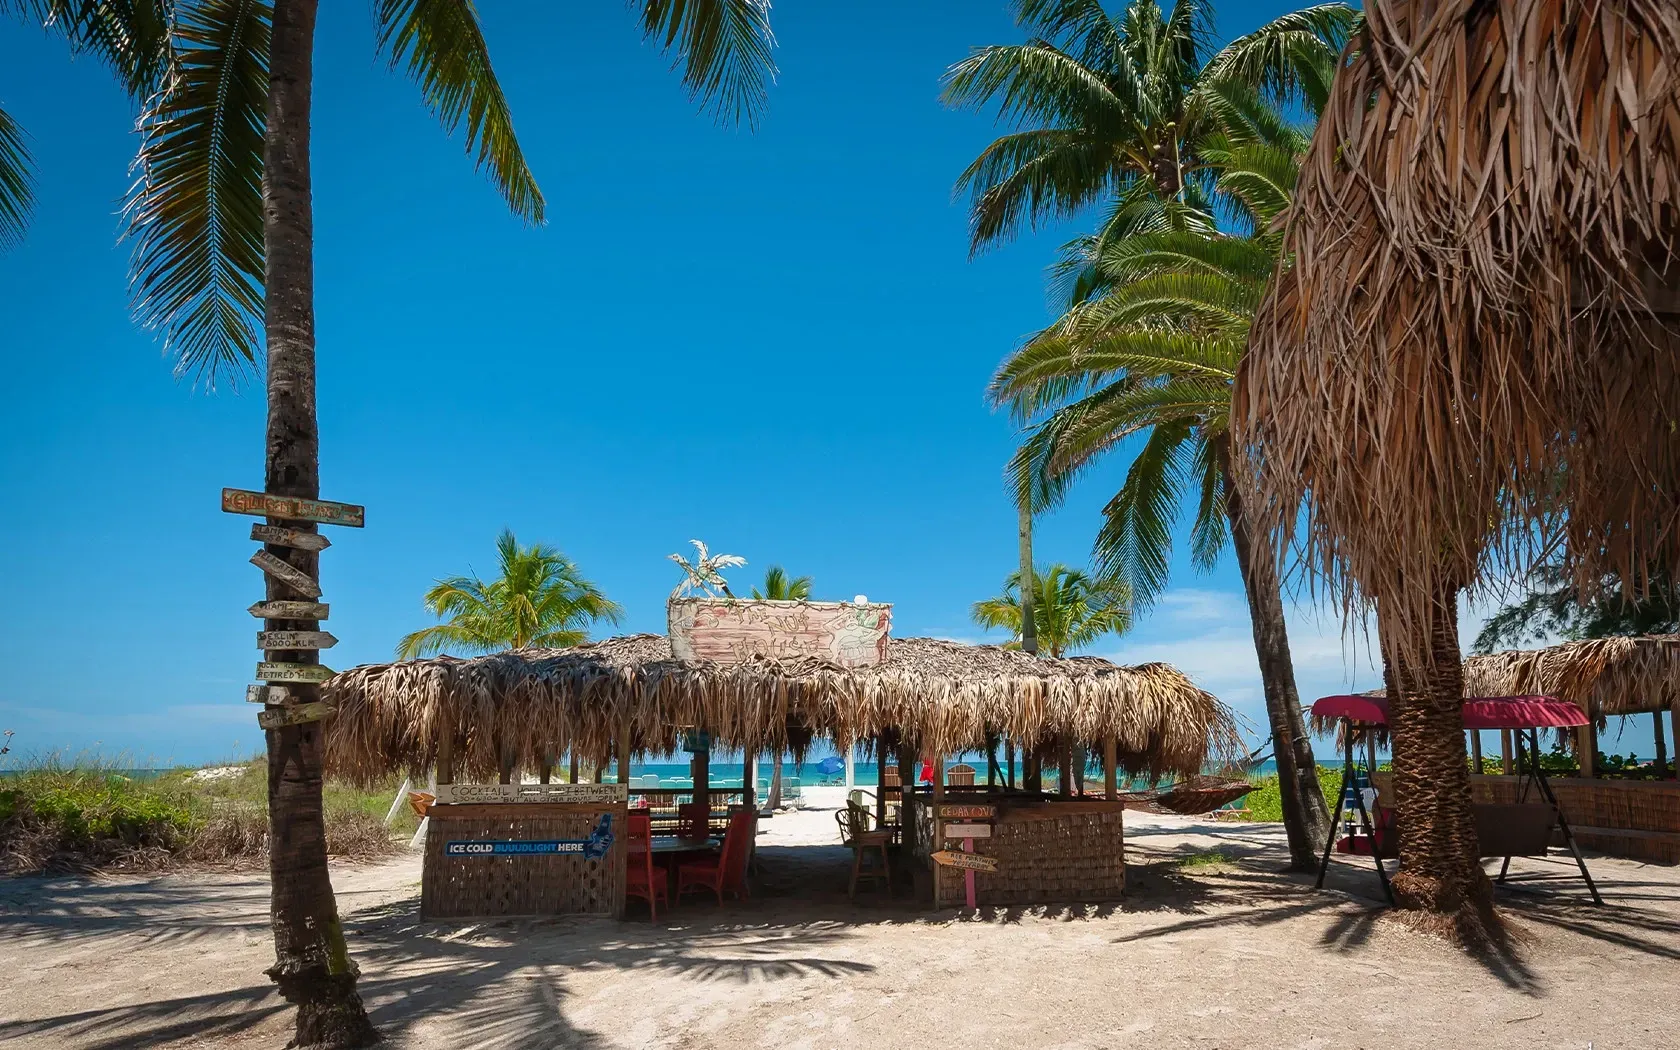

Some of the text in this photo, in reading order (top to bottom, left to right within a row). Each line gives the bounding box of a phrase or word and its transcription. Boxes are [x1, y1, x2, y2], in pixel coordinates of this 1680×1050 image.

[764, 609, 811, 637] NUT
[729, 637, 821, 662] HOUSE
[257, 671, 295, 679] RETIRED
[451, 786, 510, 796] COCKTAIL
[517, 787, 542, 797] HOUR
[940, 806, 969, 817] CEDAR
[450, 843, 584, 853] ICE COLD BUUUDLIGHT HERE
